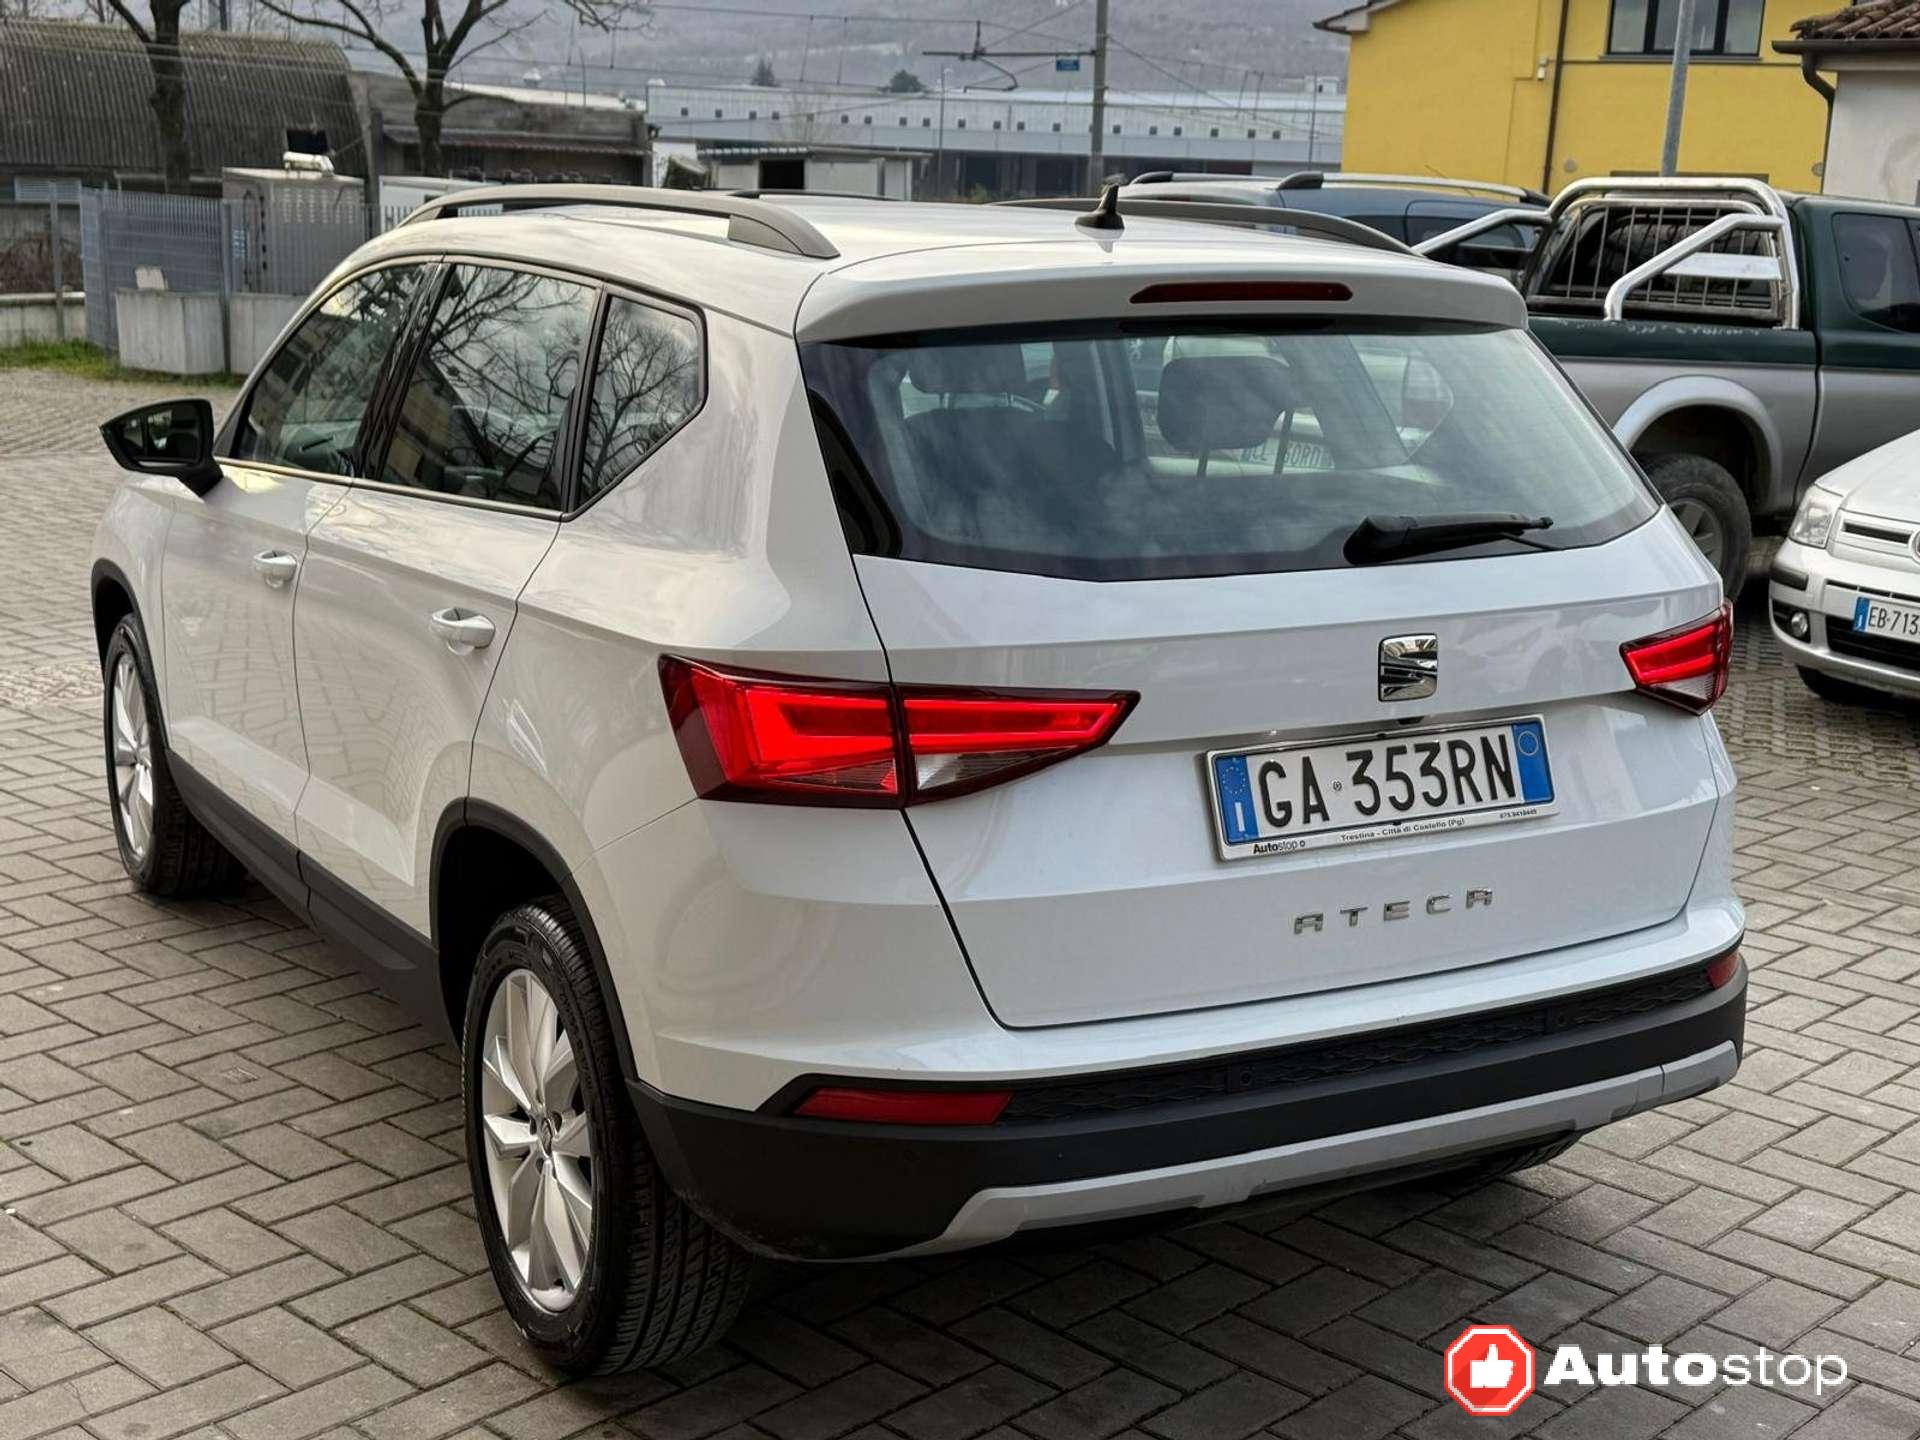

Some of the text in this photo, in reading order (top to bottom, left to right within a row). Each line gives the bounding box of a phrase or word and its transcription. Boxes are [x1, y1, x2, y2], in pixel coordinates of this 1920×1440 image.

[1868, 606, 1920, 636] EB 713
[1258, 734, 1517, 828] GA 353RN
[1253, 840, 1298, 855] Autostop
[1341, 832, 1375, 842] Trestina
[1294, 887, 1494, 935] ATECA
